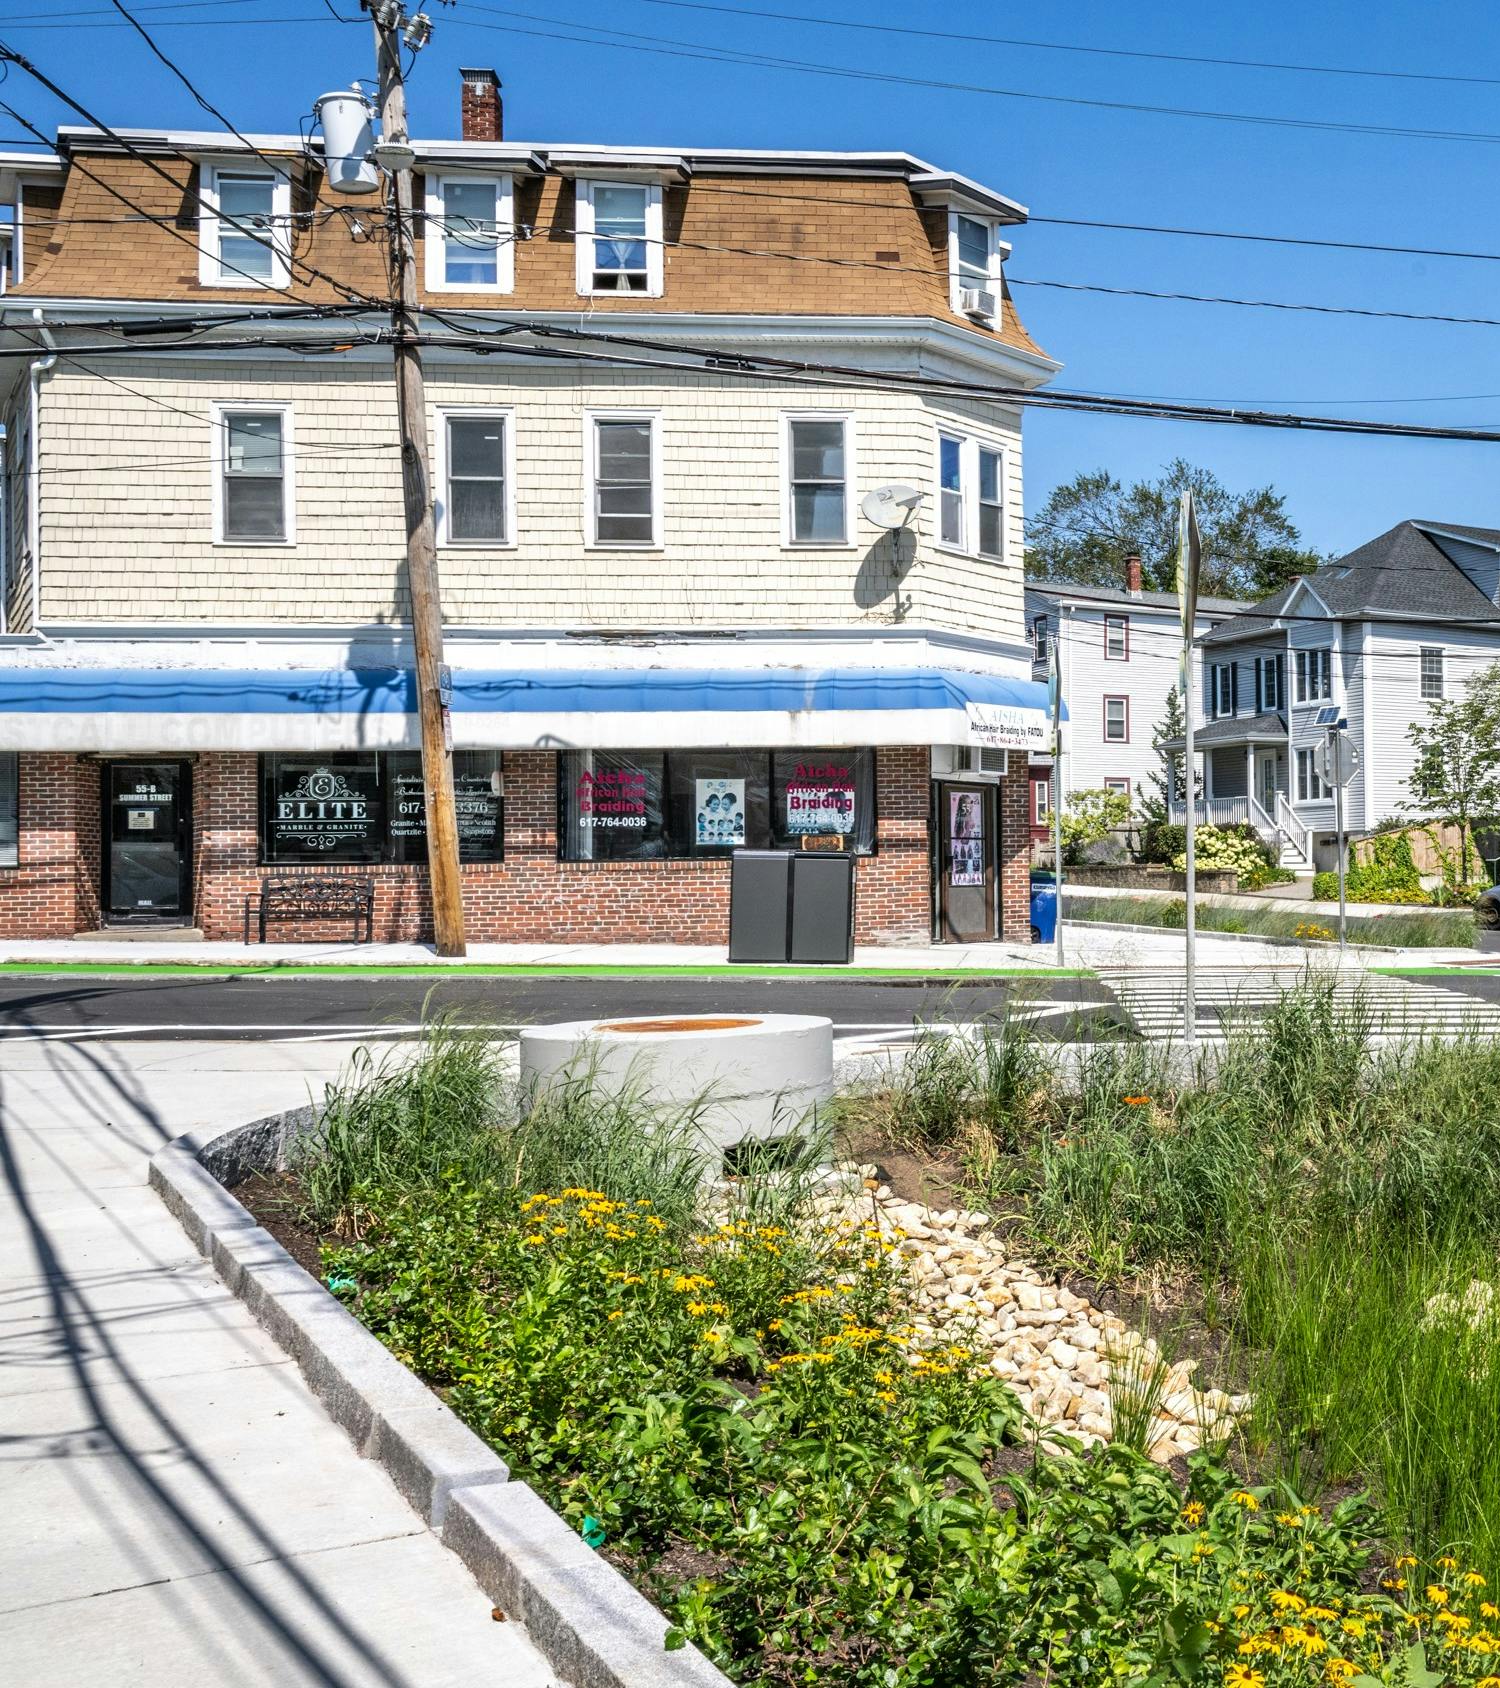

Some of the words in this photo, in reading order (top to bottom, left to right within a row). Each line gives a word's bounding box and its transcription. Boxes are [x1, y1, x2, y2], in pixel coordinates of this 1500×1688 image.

[970, 721, 989, 732] African
[989, 723, 999, 733] Hair
[1000, 724, 1020, 737] Braiding
[1020, 726, 1027, 737] by
[1027, 727, 1044, 737] FATOU
[135, 784, 157, 793] 55-B
[119, 793, 148, 801] SUMMER
[149, 793, 173, 801] STREET
[581, 800, 646, 815] Braiding
[790, 796, 853, 812] Braiding
[277, 802, 367, 819] ELITE
[390, 819, 415, 827] Granite
[580, 817, 647, 827] 617-764-0036
[391, 828, 422, 836] Quartzite
